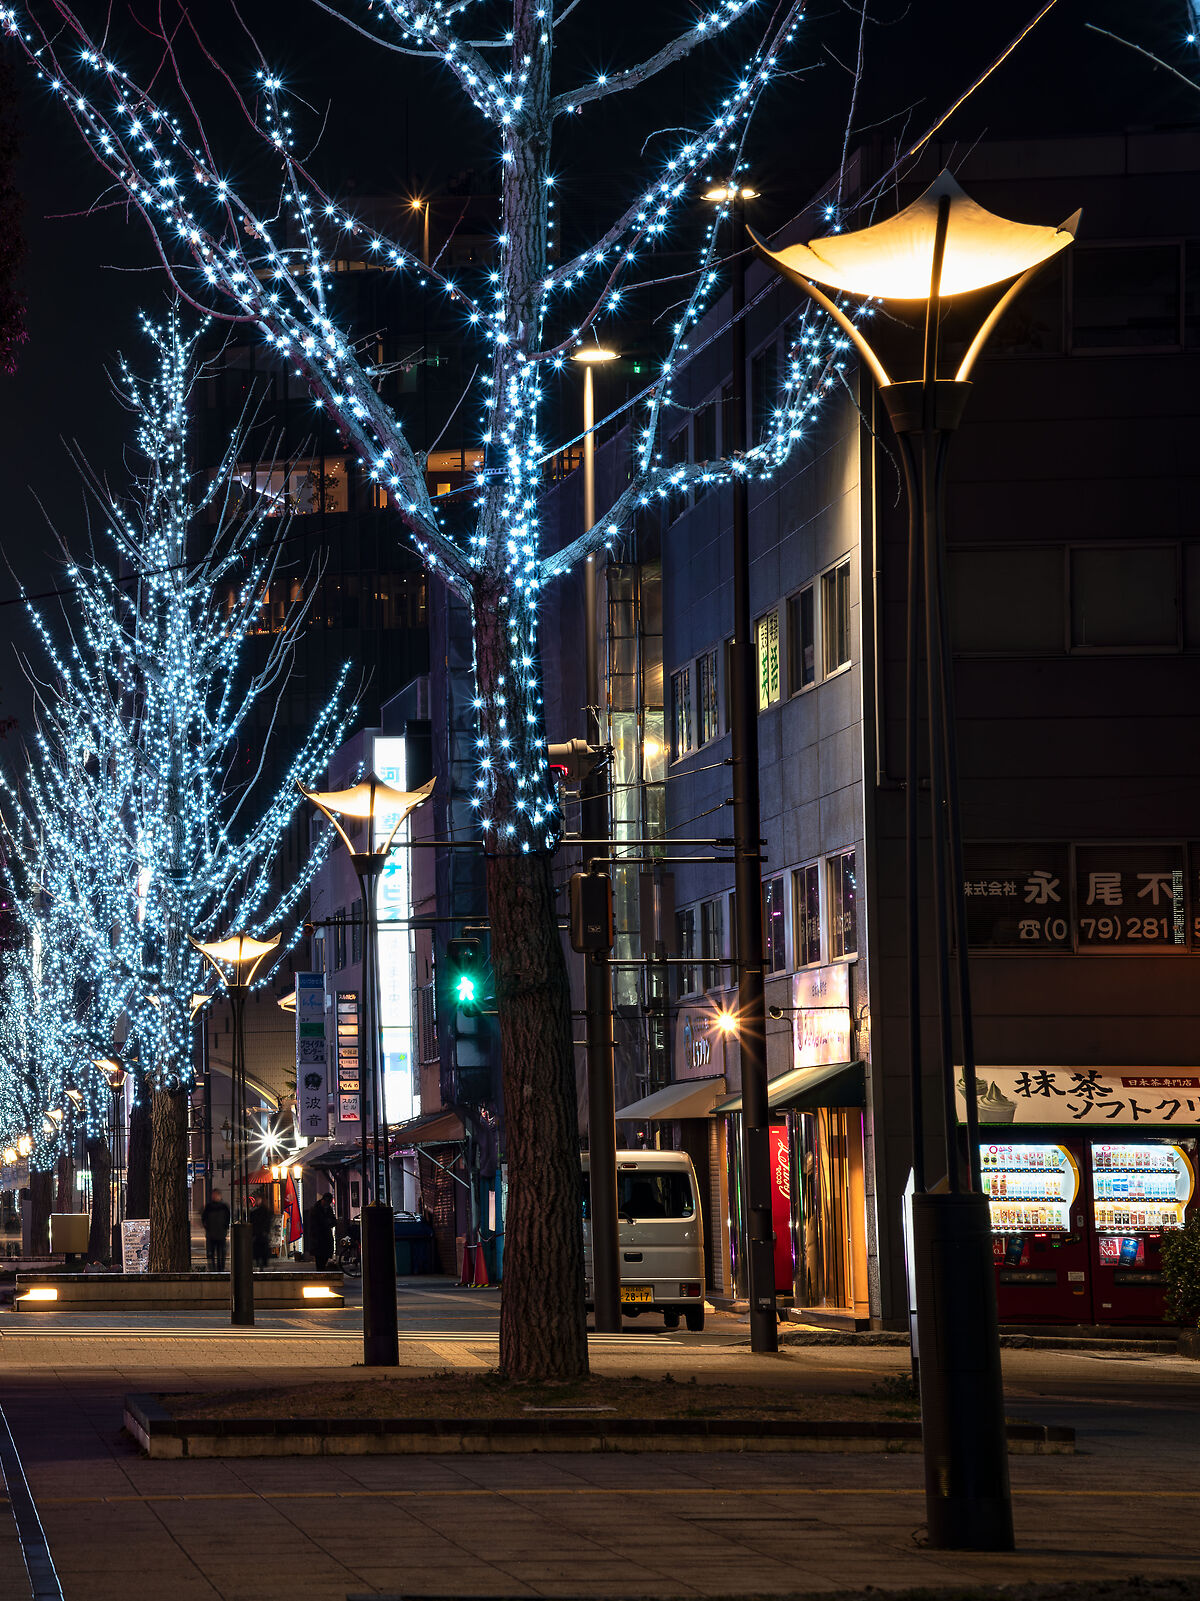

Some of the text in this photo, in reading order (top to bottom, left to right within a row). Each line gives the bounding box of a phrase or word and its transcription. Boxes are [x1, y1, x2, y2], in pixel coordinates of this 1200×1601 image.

[964, 881, 1018, 897] 株式会社
[1014, 1070, 1113, 1100] 抹茶
[306, 1097, 322, 1127] 波音
[625, 1292, 649, 1301] 28-17
